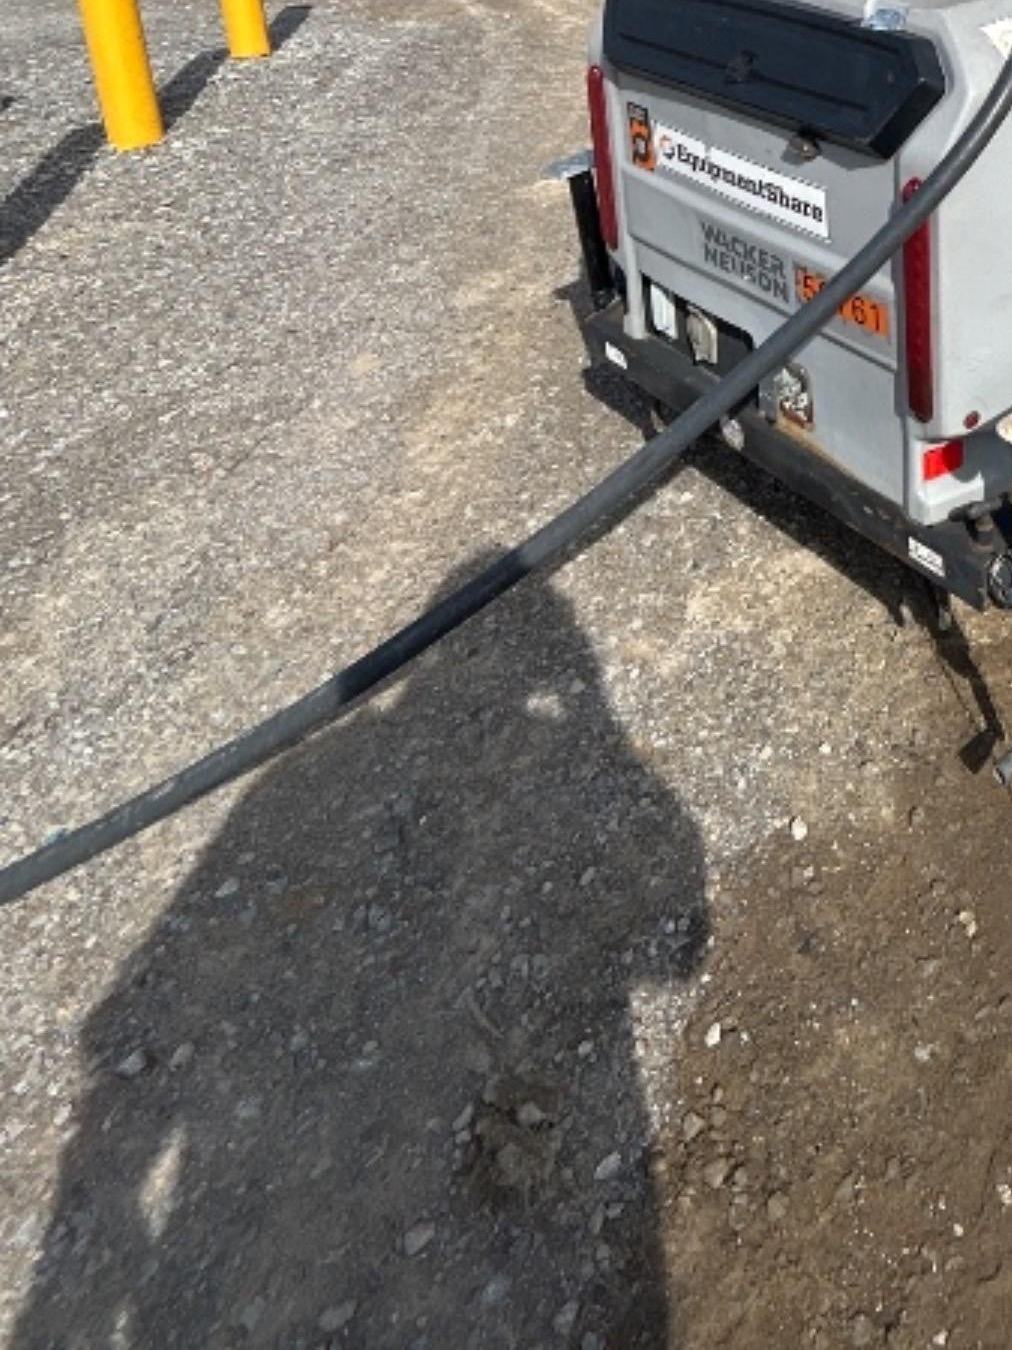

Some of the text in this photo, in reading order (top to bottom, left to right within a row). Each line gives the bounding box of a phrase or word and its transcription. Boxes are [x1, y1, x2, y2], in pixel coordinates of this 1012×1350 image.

[677, 143, 823, 222] EquipmentShare
[701, 221, 785, 279] WACKER
[704, 244, 790, 304] NEUSON
